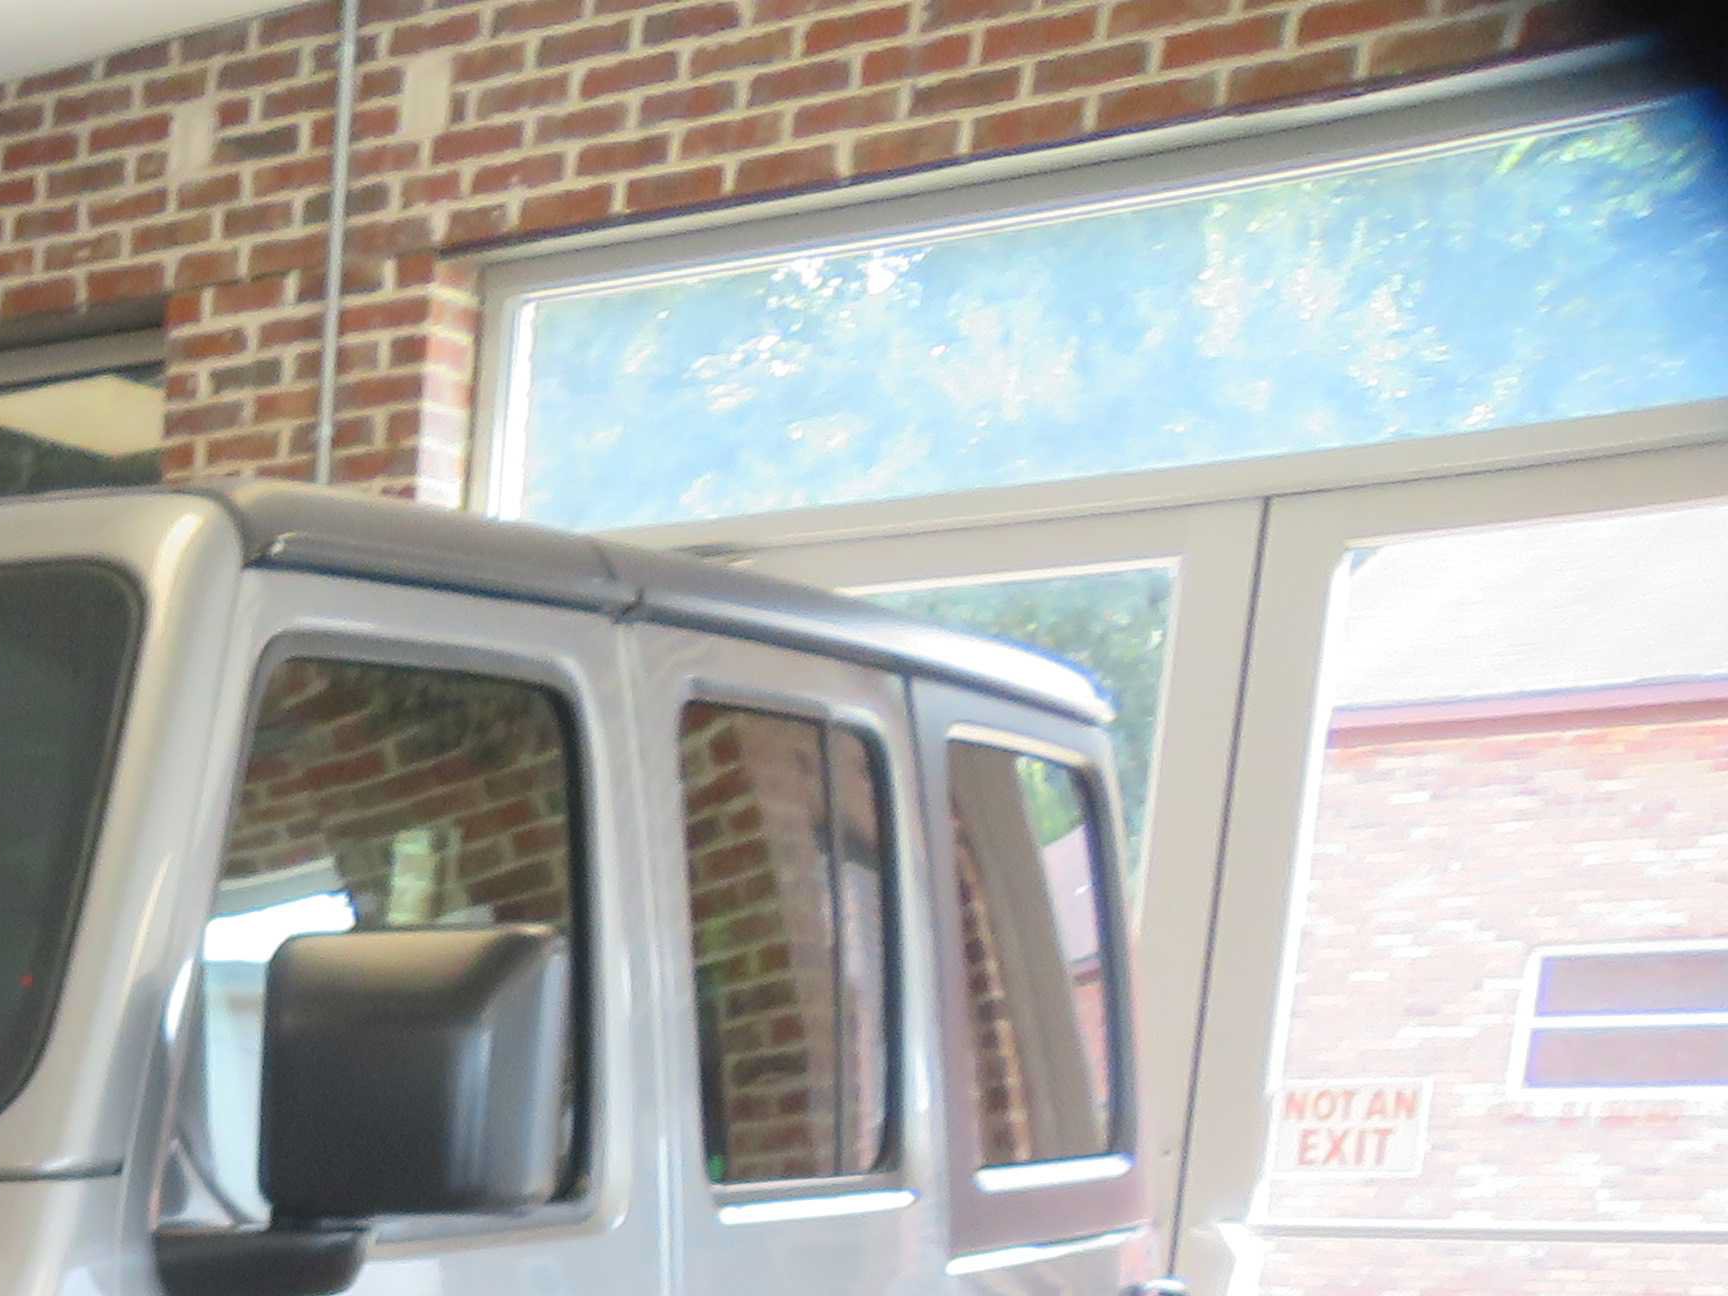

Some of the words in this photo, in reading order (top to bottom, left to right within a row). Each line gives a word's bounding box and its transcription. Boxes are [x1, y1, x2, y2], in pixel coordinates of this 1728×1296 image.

[1283, 1088, 1358, 1120] NOT
[1366, 1088, 1418, 1120] AN
[1297, 1127, 1394, 1165] EXIT
